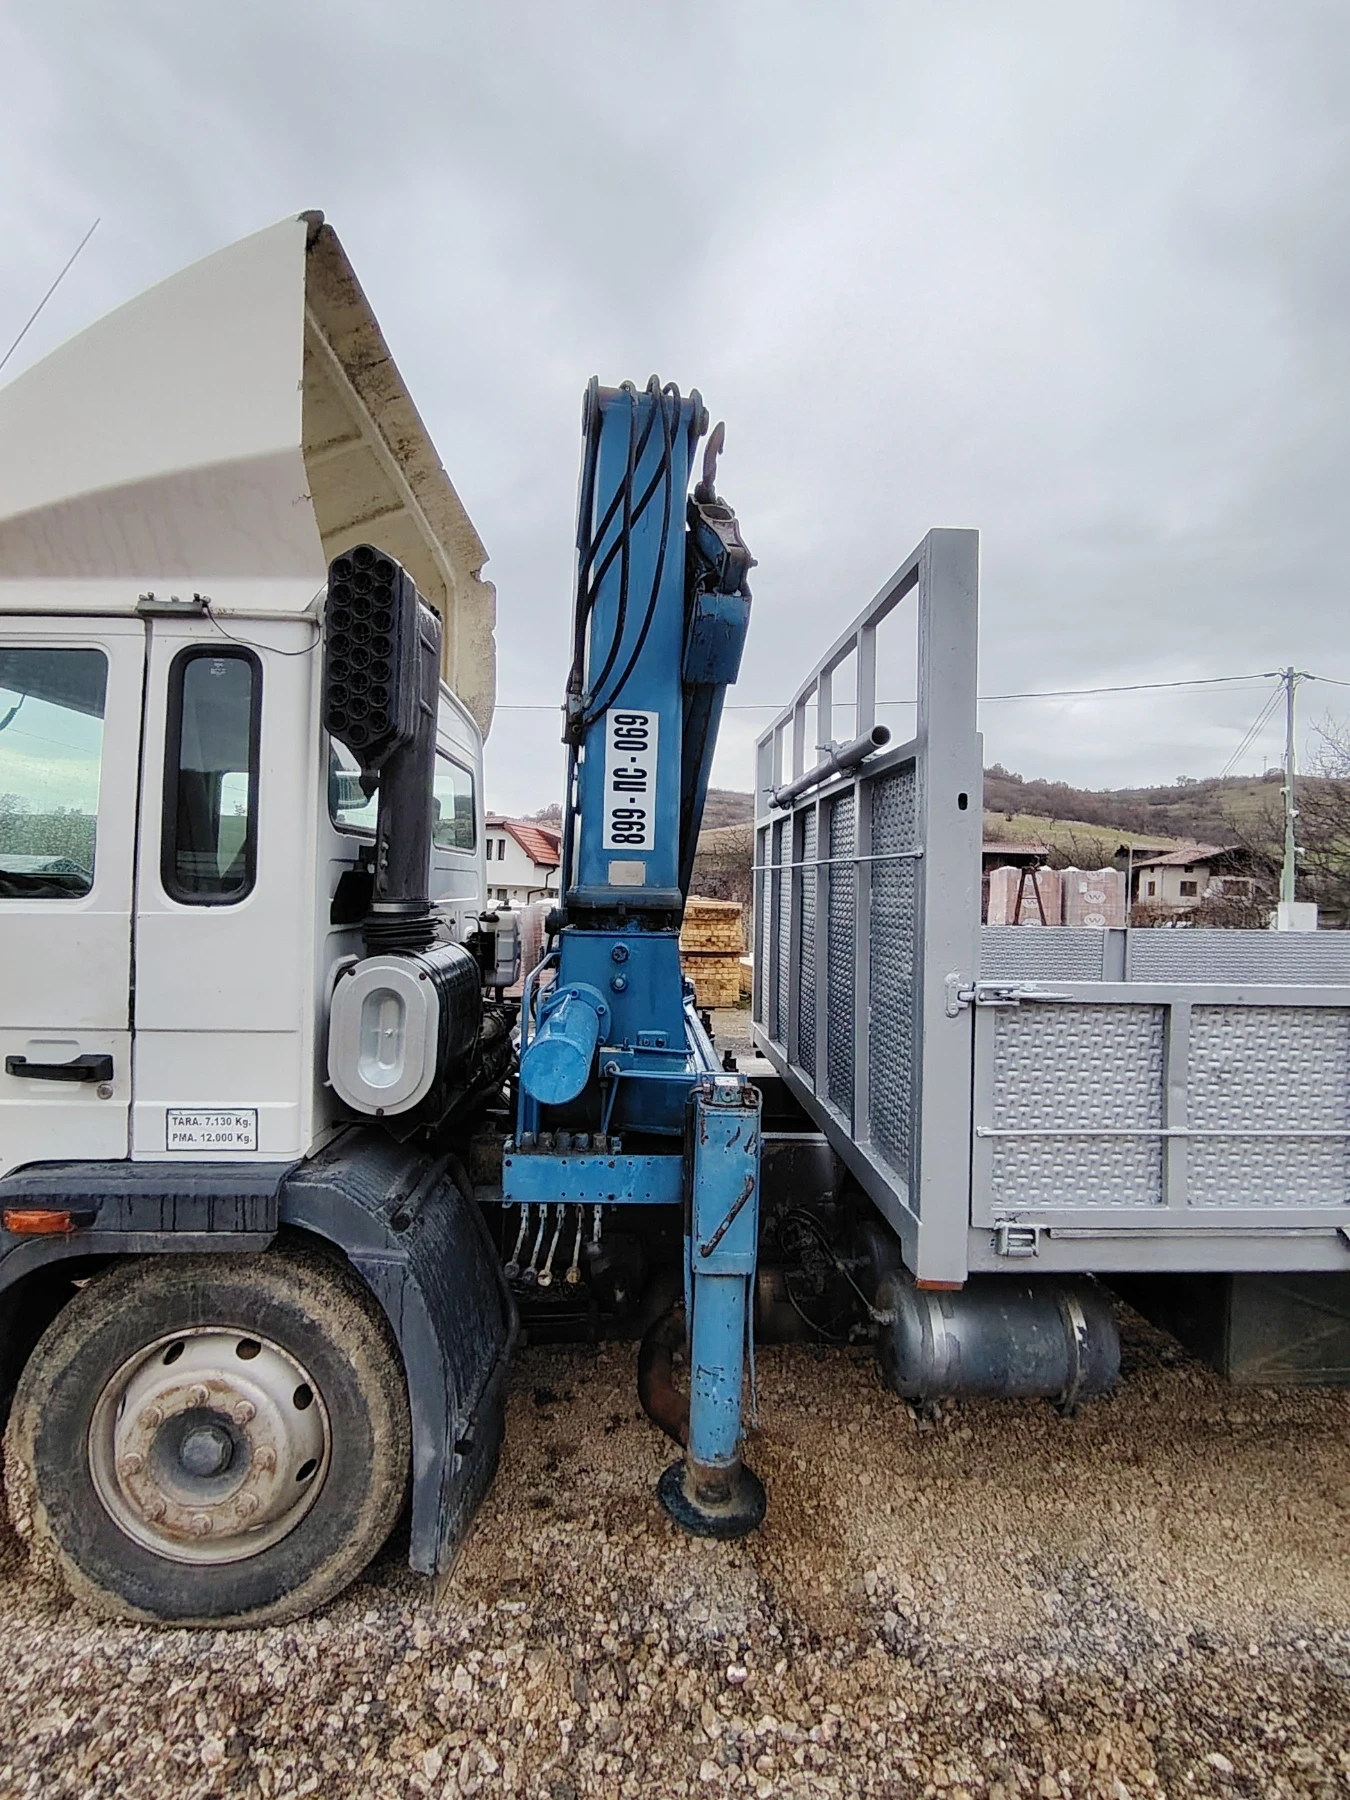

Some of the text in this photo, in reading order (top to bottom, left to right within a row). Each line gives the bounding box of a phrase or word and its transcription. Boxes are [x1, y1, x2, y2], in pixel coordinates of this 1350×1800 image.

[172, 1117, 252, 1129] TARA. 7.130 Kg.
[172, 1133, 253, 1145] PMA. 12.000 Kg.
